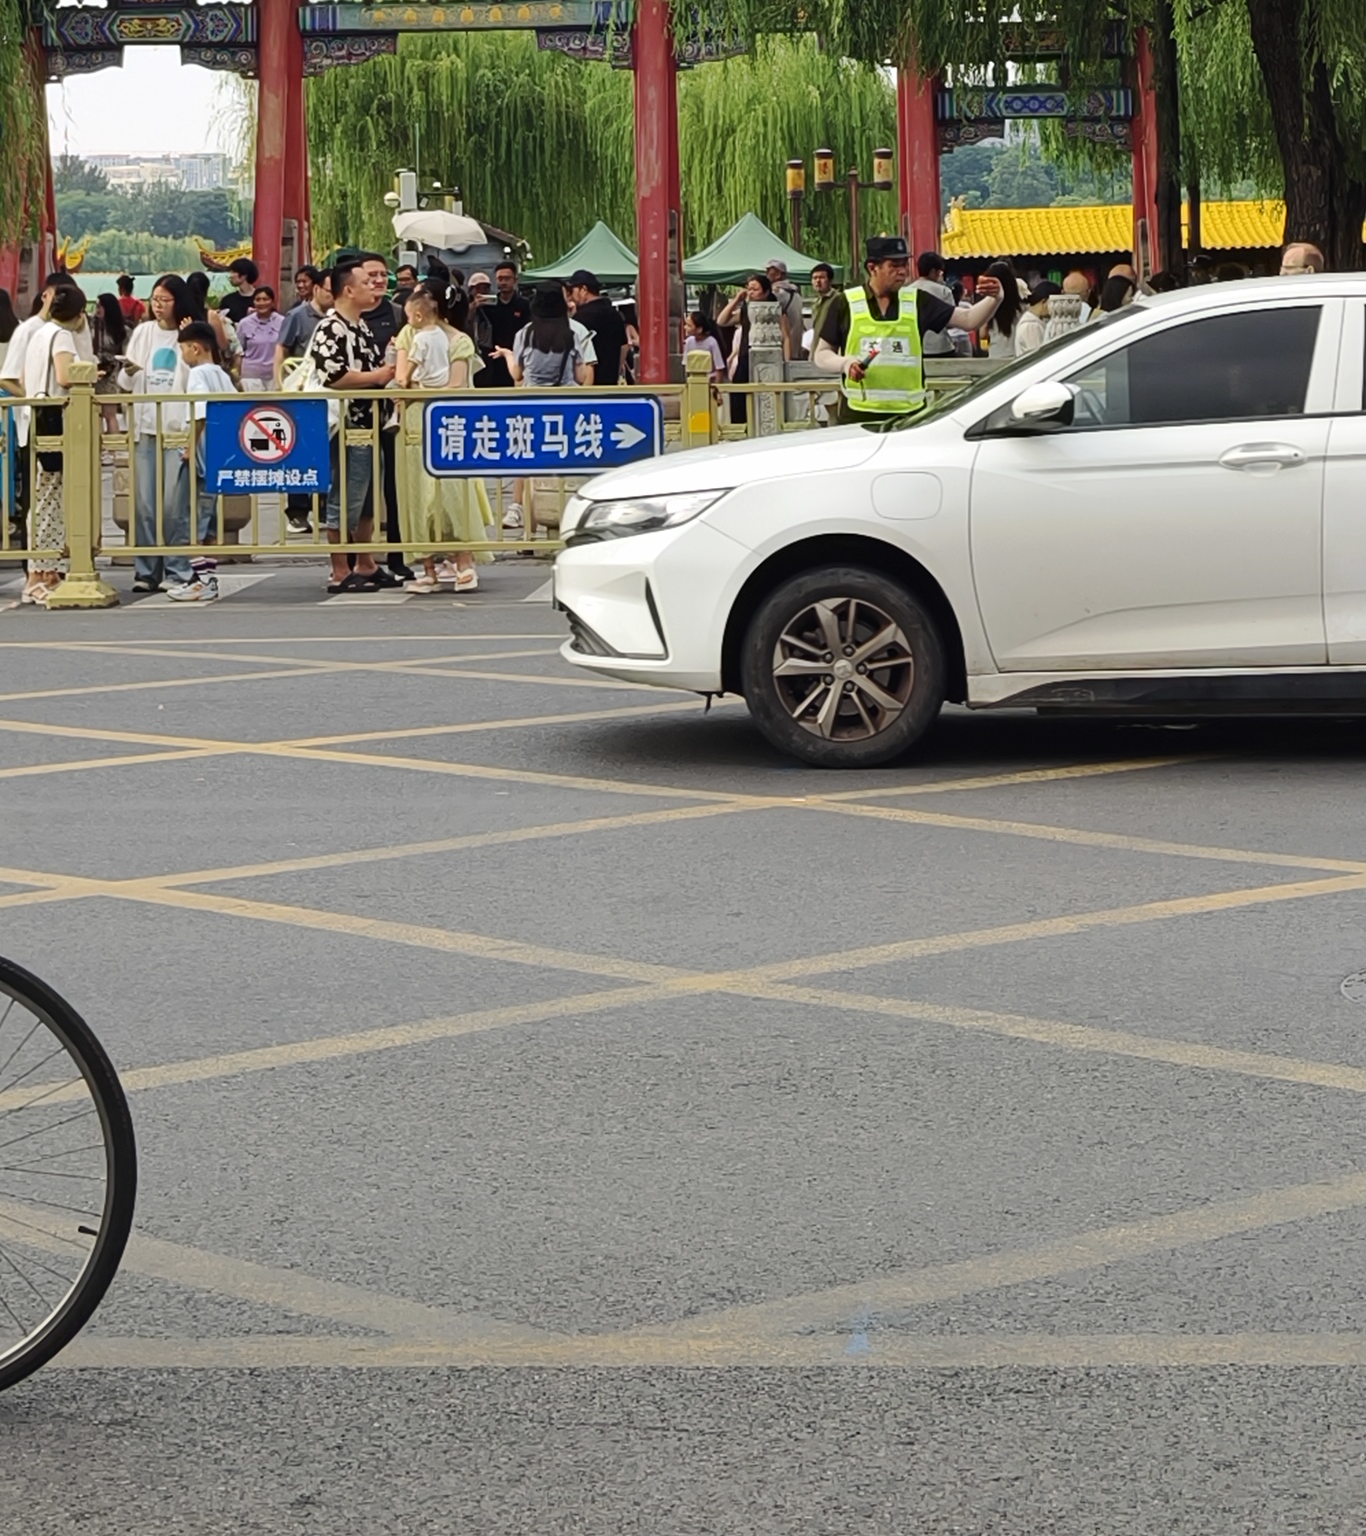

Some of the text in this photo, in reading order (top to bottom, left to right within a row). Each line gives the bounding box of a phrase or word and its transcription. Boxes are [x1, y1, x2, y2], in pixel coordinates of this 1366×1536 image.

[437, 413, 603, 461] 请走斑马线
[217, 468, 319, 487] 严禁摆摊设点
